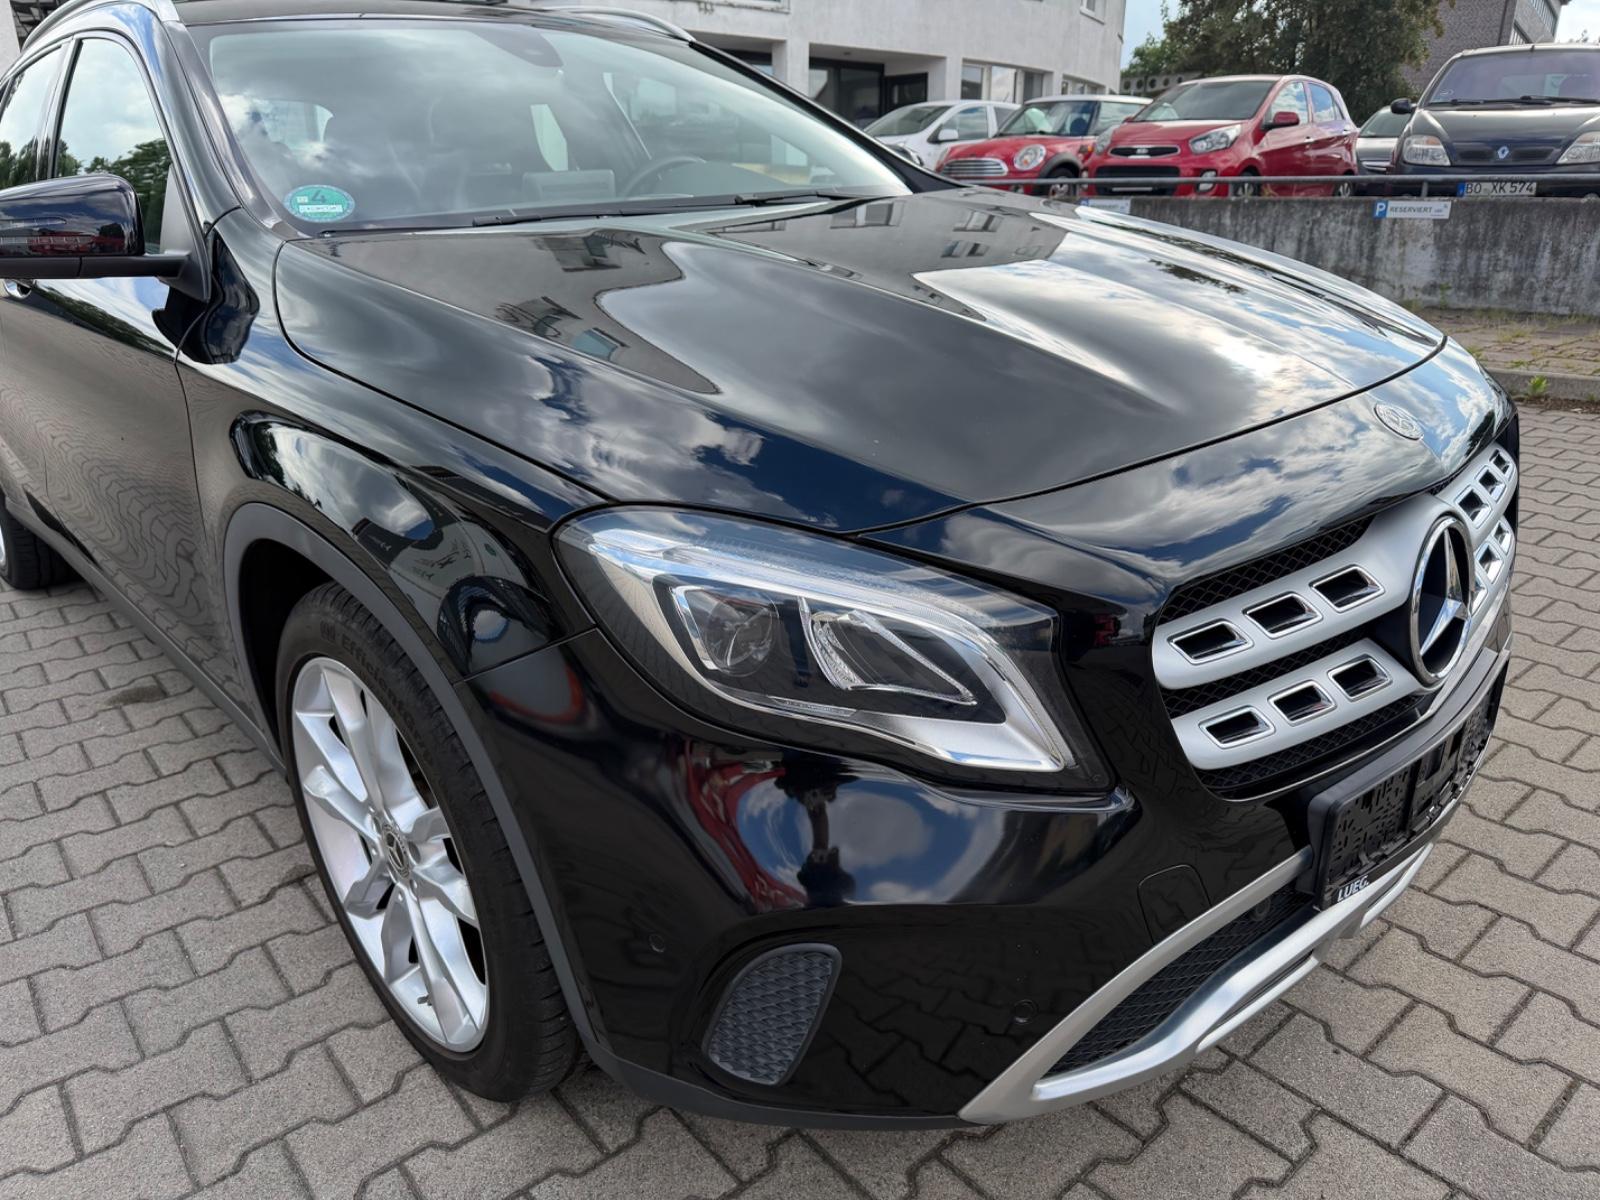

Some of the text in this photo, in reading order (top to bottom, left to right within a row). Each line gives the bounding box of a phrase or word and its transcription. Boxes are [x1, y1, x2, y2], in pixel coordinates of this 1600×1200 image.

[1466, 181, 1533, 194] BO XK 574
[311, 189, 327, 203] 4
[1376, 202, 1386, 217] P
